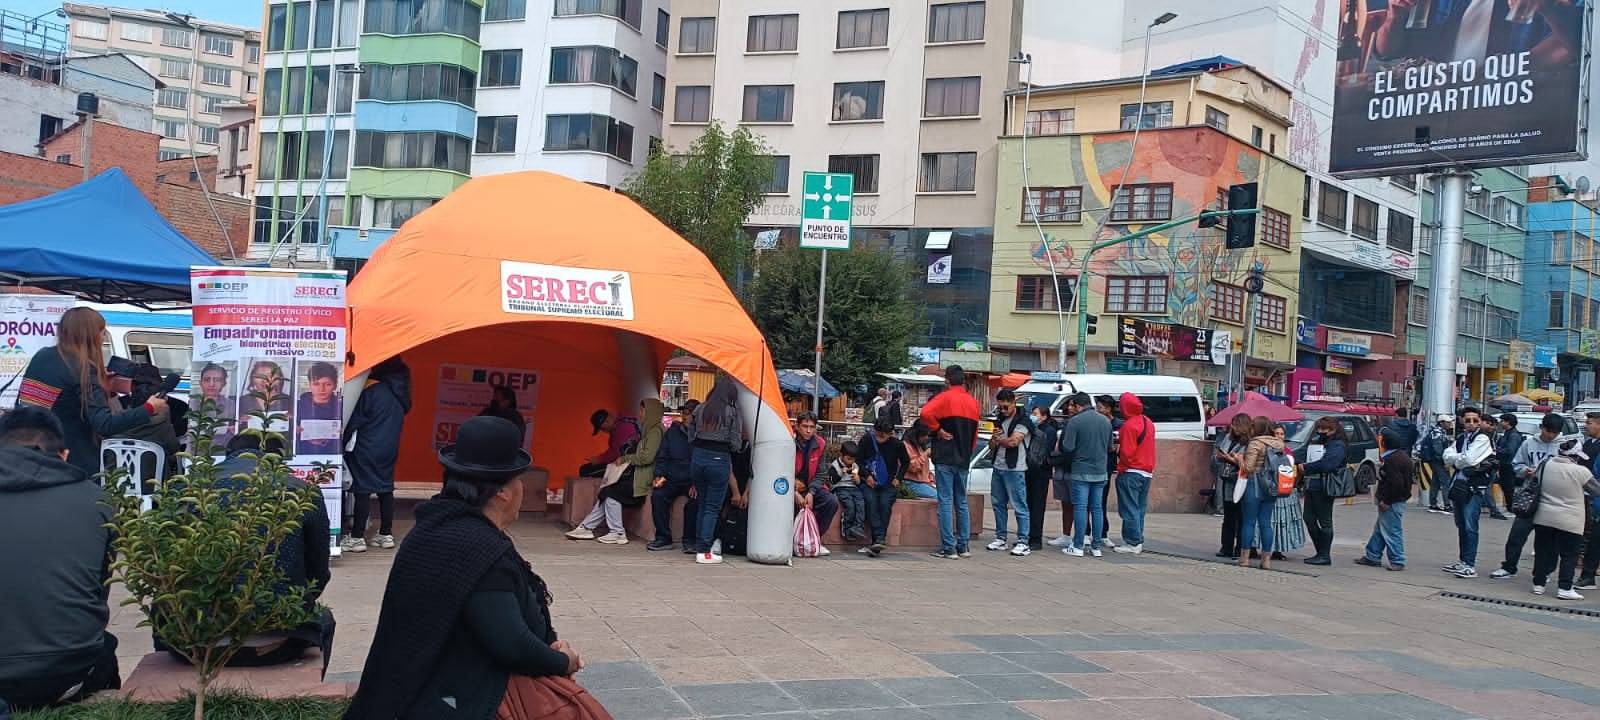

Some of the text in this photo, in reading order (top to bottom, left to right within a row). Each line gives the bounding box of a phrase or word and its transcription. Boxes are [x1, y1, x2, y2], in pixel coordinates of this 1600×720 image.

[1374, 51, 1531, 94] EL GUSTO QUE
[1367, 79, 1534, 121] COMPARTIMOS
[807, 224, 845, 233] PUNTO DE
[803, 231, 848, 241] ENCUENTRO
[222, 282, 249, 291] OEP
[261, 308, 303, 316] REGISTRO
[508, 303, 625, 317] TRIBUNAL SUPREMO ELECTORAL
[283, 316, 299, 324] PAZ
[203, 326, 337, 341] Empadronamiento
[239, 339, 337, 350] biométrico electoral
[265, 348, 337, 358] masivo 2025
[488, 370, 537, 391] OEP
